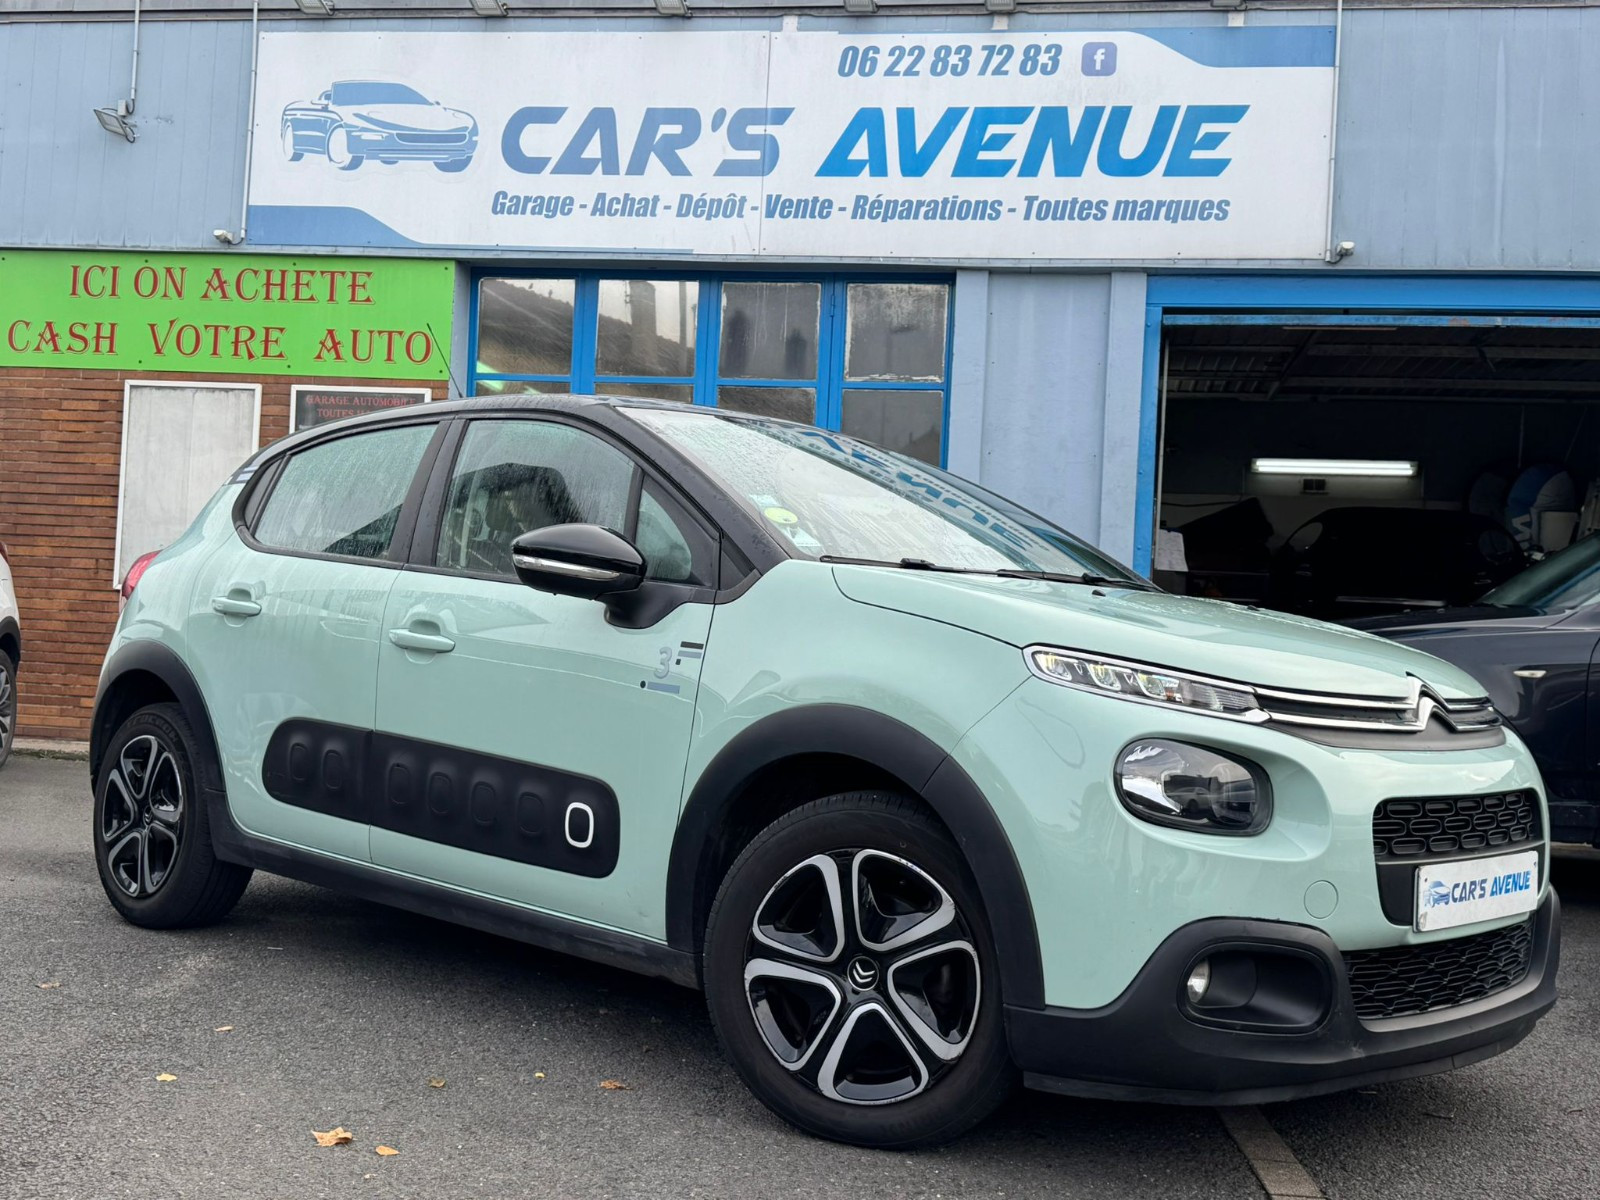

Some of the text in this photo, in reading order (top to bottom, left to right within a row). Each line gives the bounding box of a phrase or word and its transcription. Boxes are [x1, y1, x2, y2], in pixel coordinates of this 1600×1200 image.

[838, 44, 1063, 78] 06 22 83 72 83
[501, 104, 1251, 179] CAR'S AVENUE
[491, 191, 574, 220] Garage
[591, 192, 661, 218] Achat
[676, 192, 747, 222] Dépôt
[764, 192, 834, 221] Vente
[851, 194, 1004, 224] Réparations
[1023, 196, 1108, 222] Toutes
[1112, 199, 1231, 224] marques
[69, 264, 375, 305] ICI ON ACHETE
[7, 318, 433, 364] CASH VOTRE AUTO
[305, 395, 349, 406] GARAGE
[317, 408, 354, 418] TOUTES
[1451, 870, 1532, 904] CAR'S AVENUE
